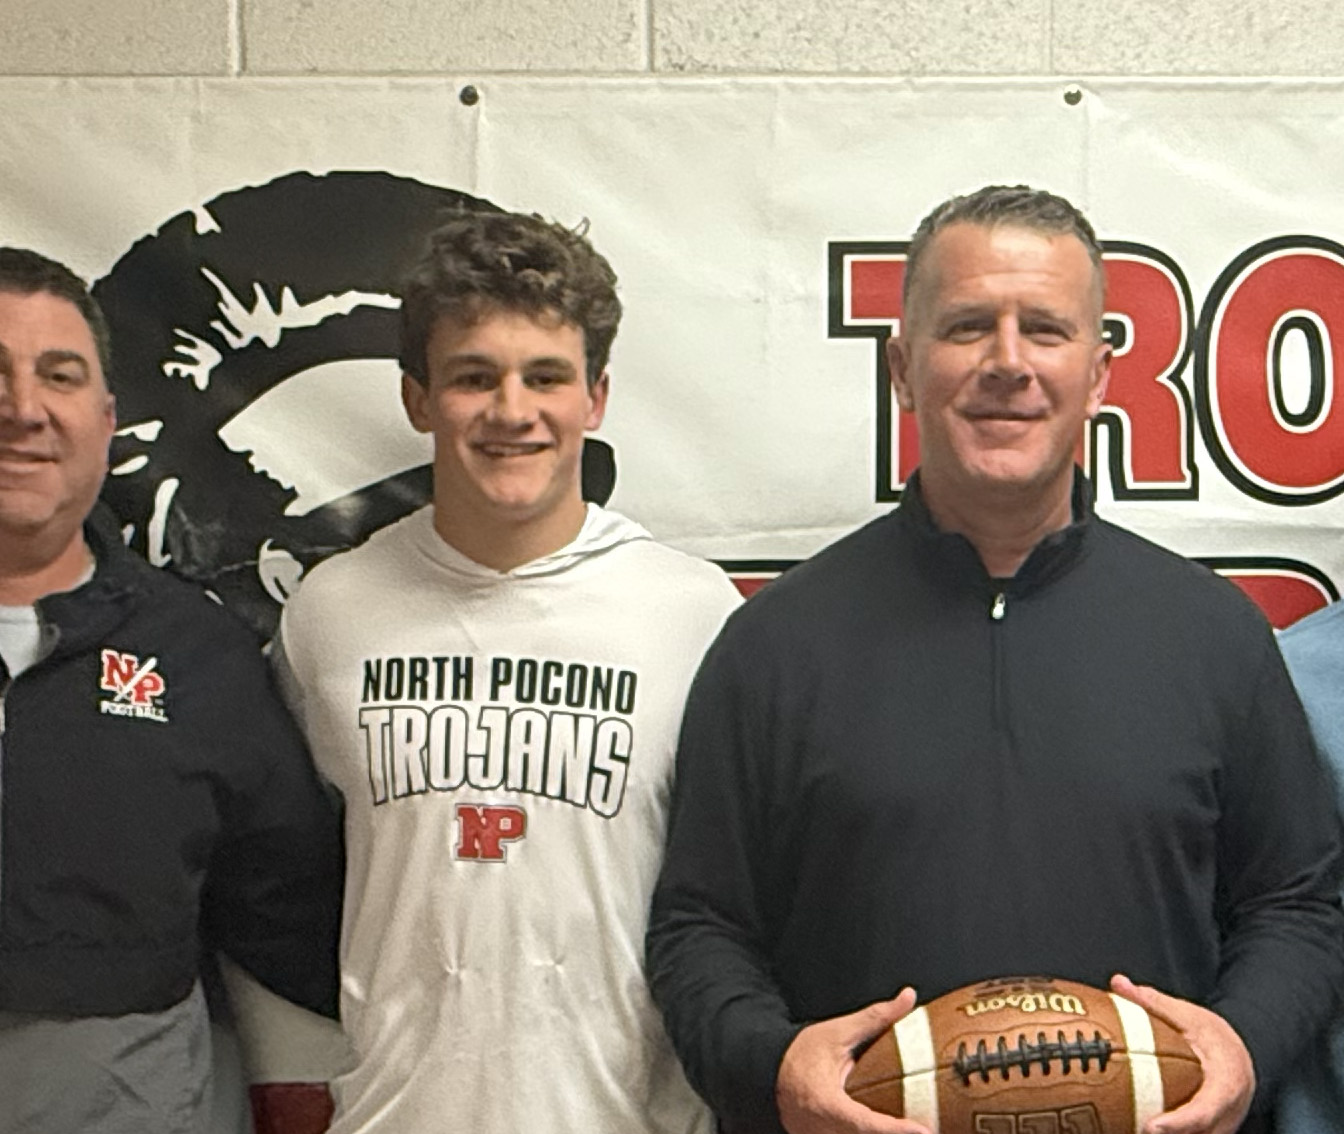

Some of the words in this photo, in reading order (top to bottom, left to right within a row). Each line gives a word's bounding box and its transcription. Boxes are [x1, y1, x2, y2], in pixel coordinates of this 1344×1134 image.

[361, 656, 474, 702] NORTH
[489, 656, 638, 715] POCONO
[358, 704, 634, 819] TROJANS
[455, 803, 528, 863] NP
[964, 991, 1088, 1018] Wilson
